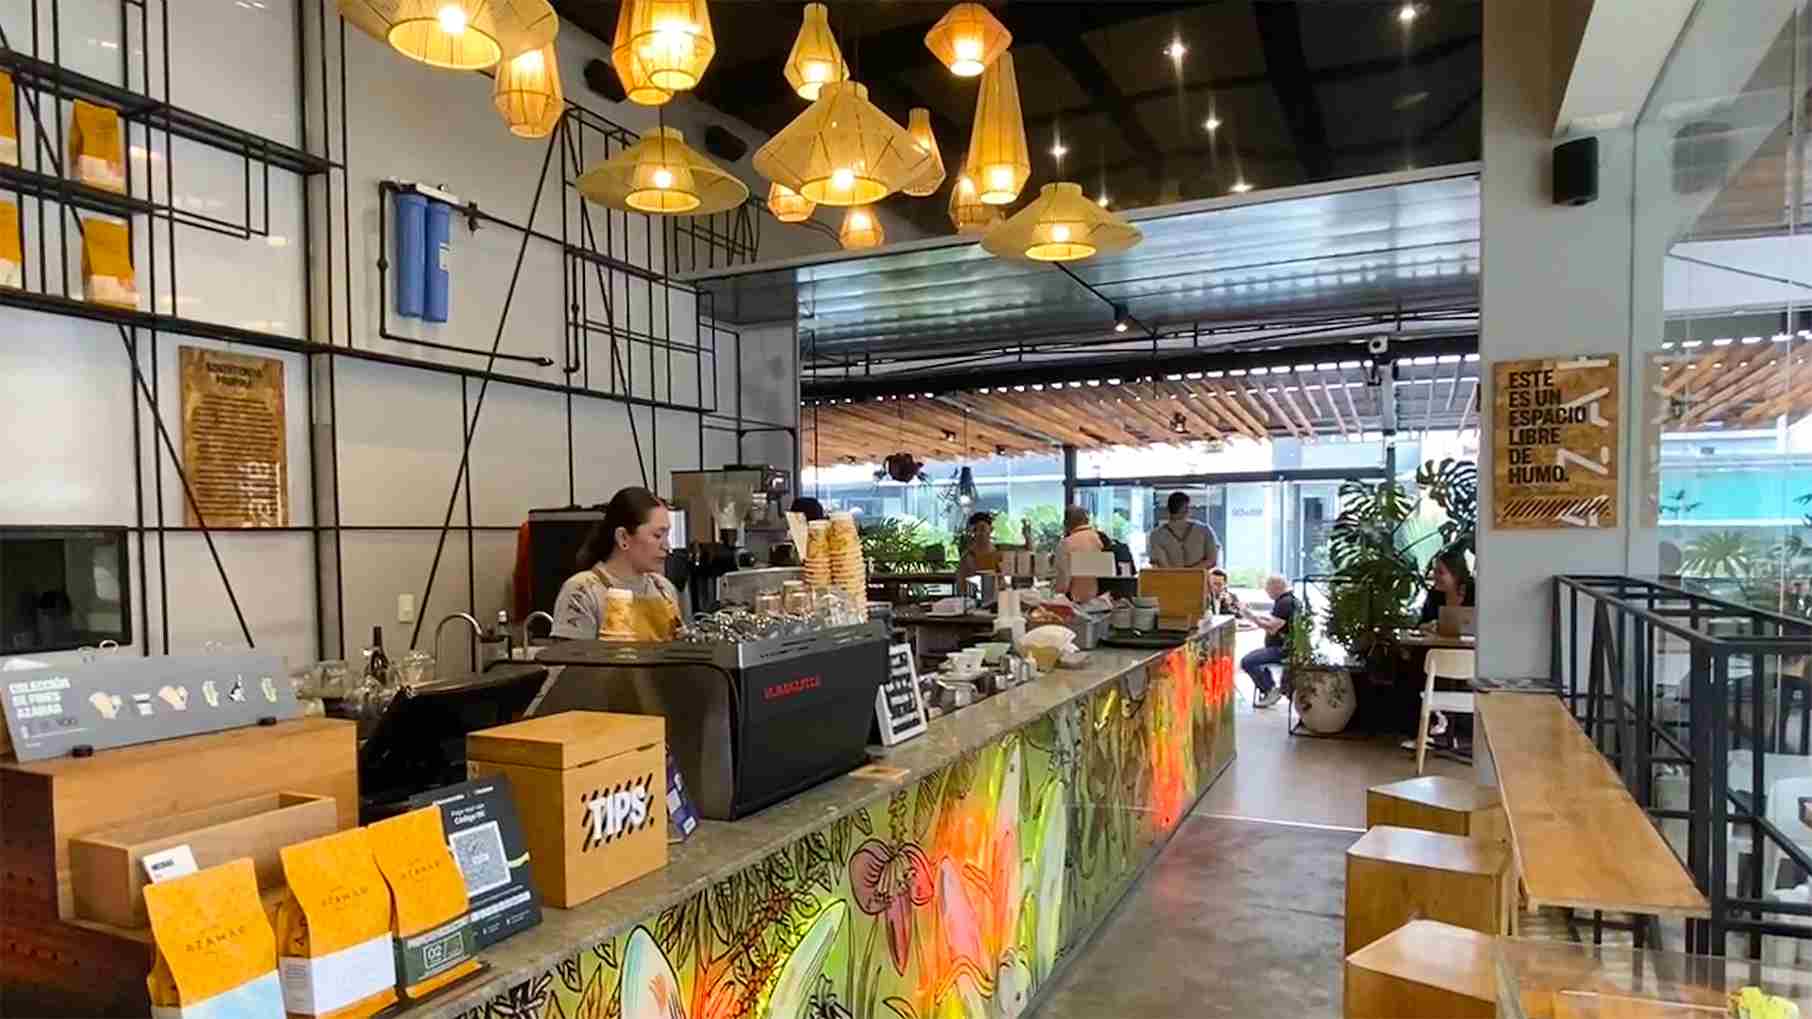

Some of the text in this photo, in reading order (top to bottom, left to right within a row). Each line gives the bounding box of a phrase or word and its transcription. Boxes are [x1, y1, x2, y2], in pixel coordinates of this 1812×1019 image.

[1508, 370, 1554, 389] ESTE
[1508, 389, 1562, 408] ES UN
[1508, 406, 1586, 427] ESPACIO
[1508, 427, 1561, 445] LIBRE
[1508, 448, 1532, 465] DE
[1508, 465, 1570, 484] HUMO.
[587, 783, 647, 841] TIPS
